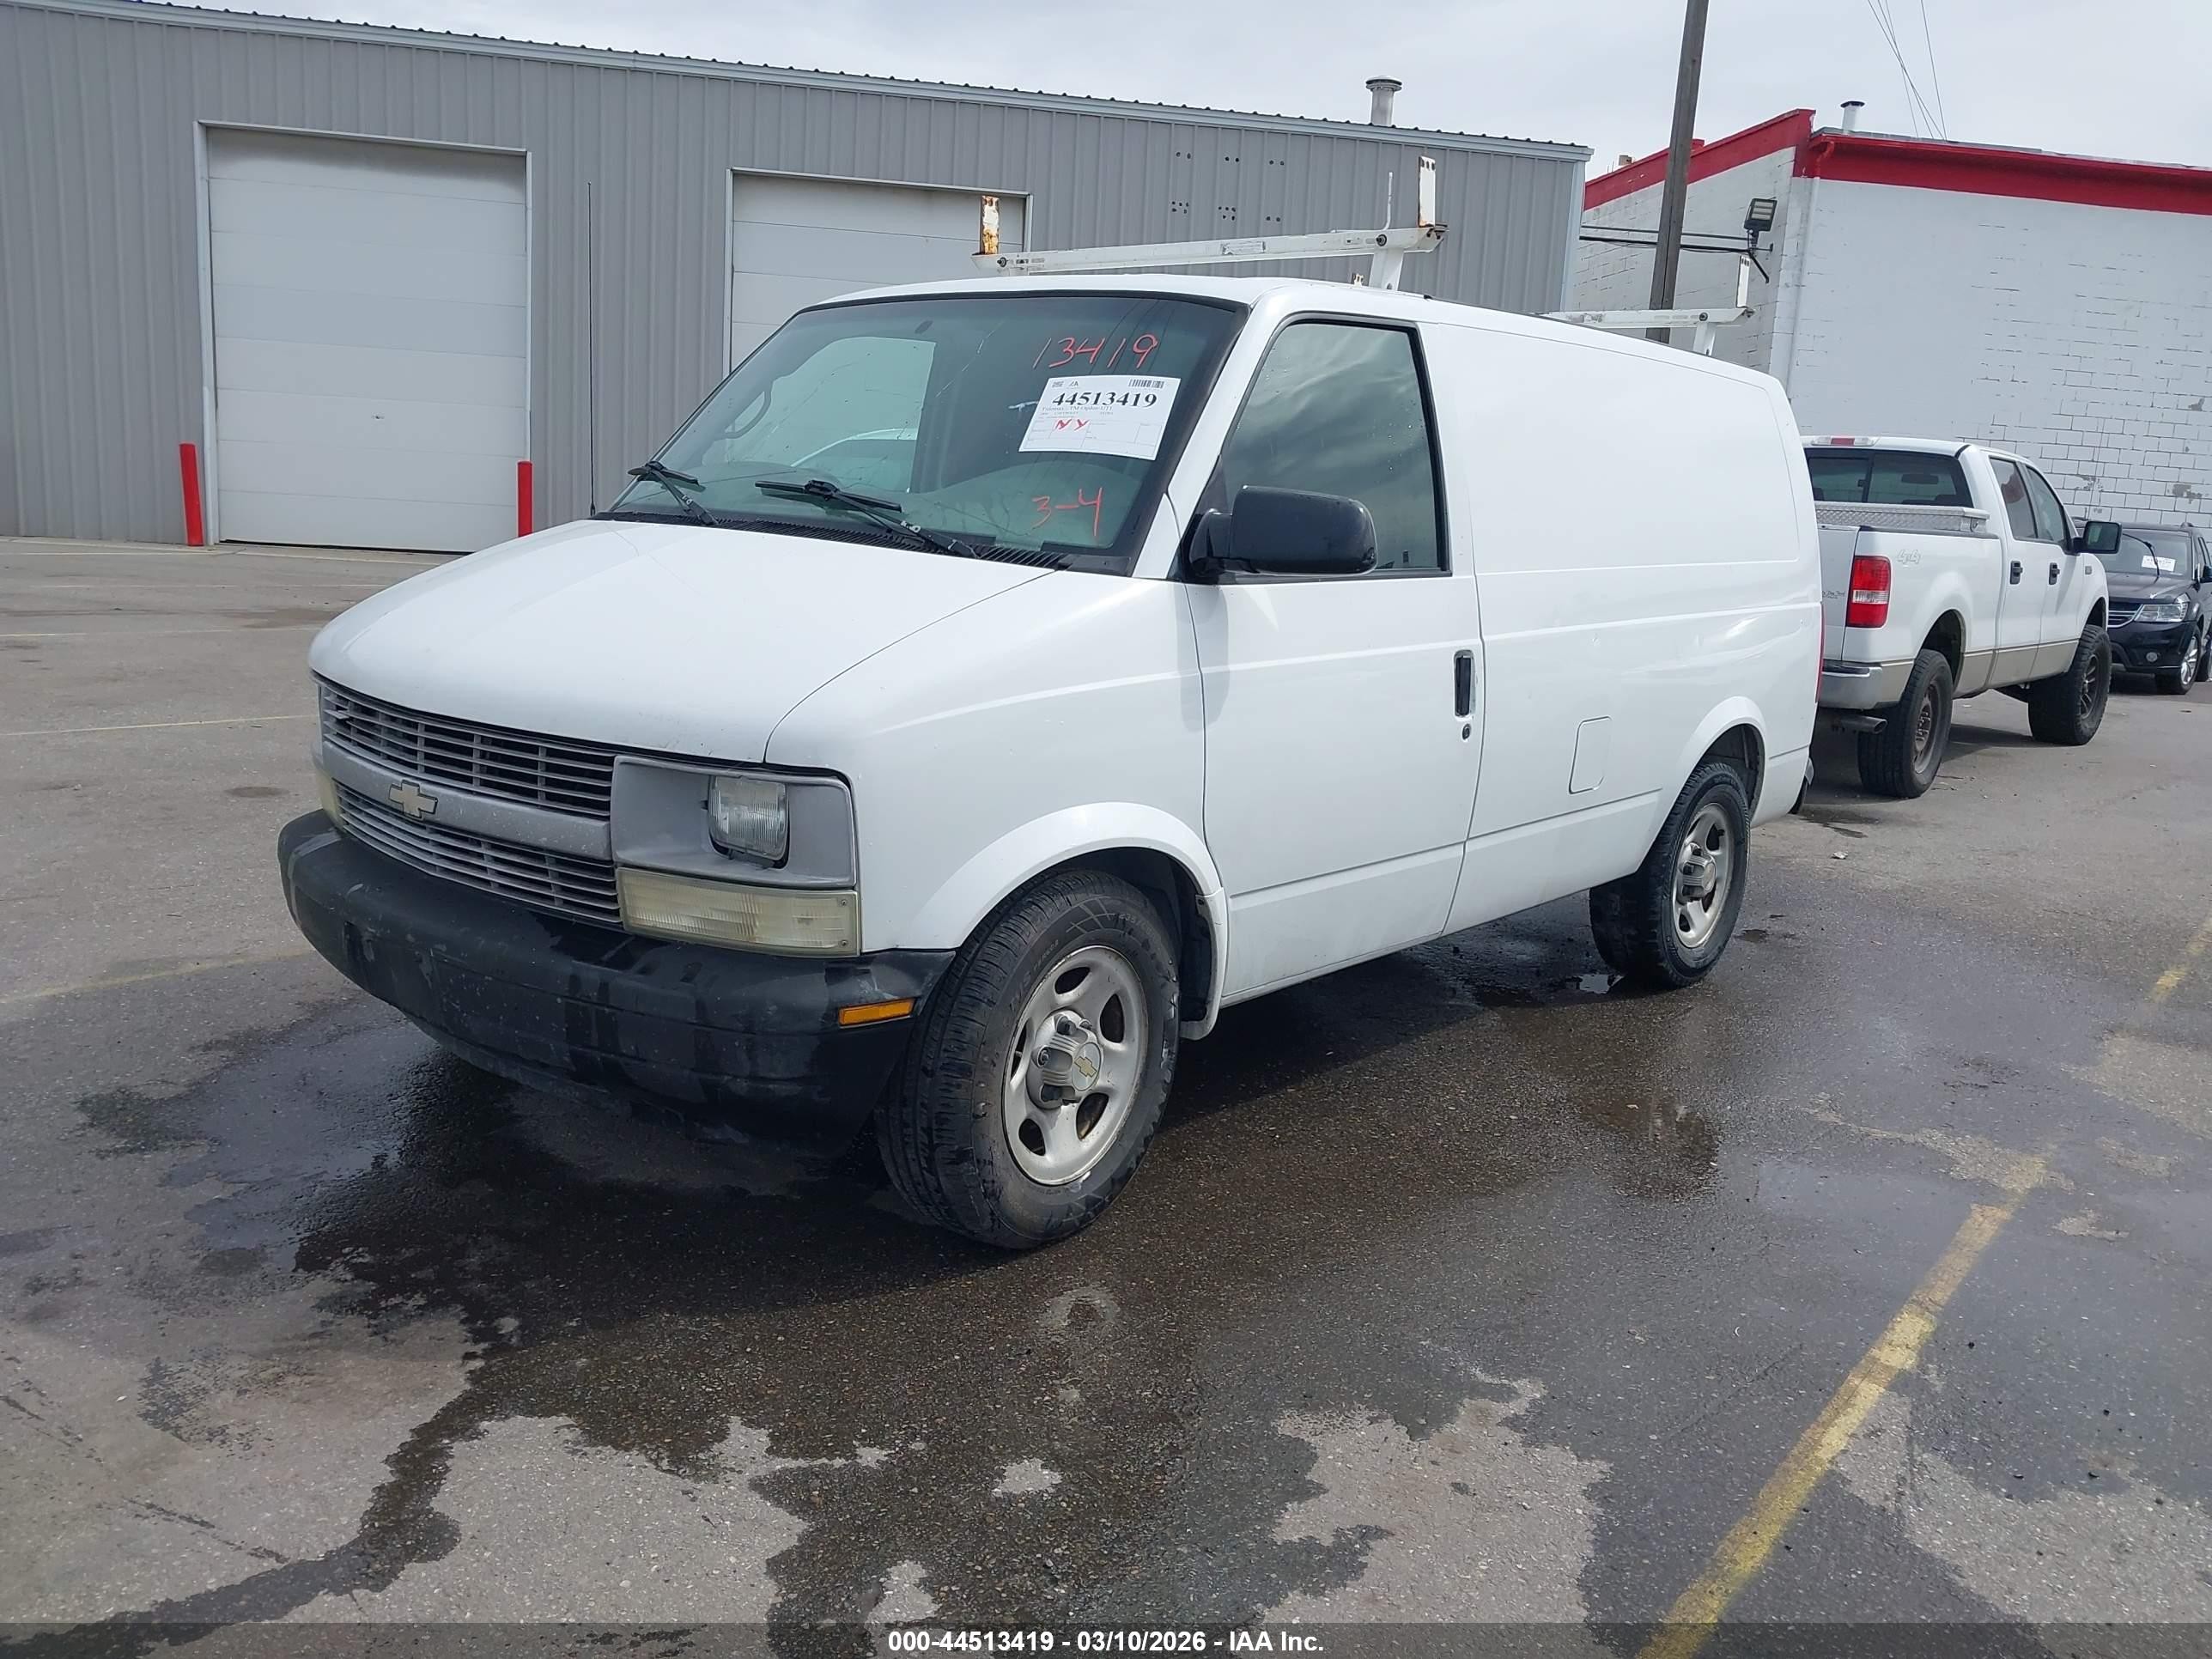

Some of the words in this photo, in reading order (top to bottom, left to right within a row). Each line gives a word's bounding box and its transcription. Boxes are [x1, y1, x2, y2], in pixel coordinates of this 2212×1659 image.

[1033, 334, 1158, 369] 13419
[1052, 392, 1158, 408] 44513419
[1032, 487, 1103, 537] 3-4
